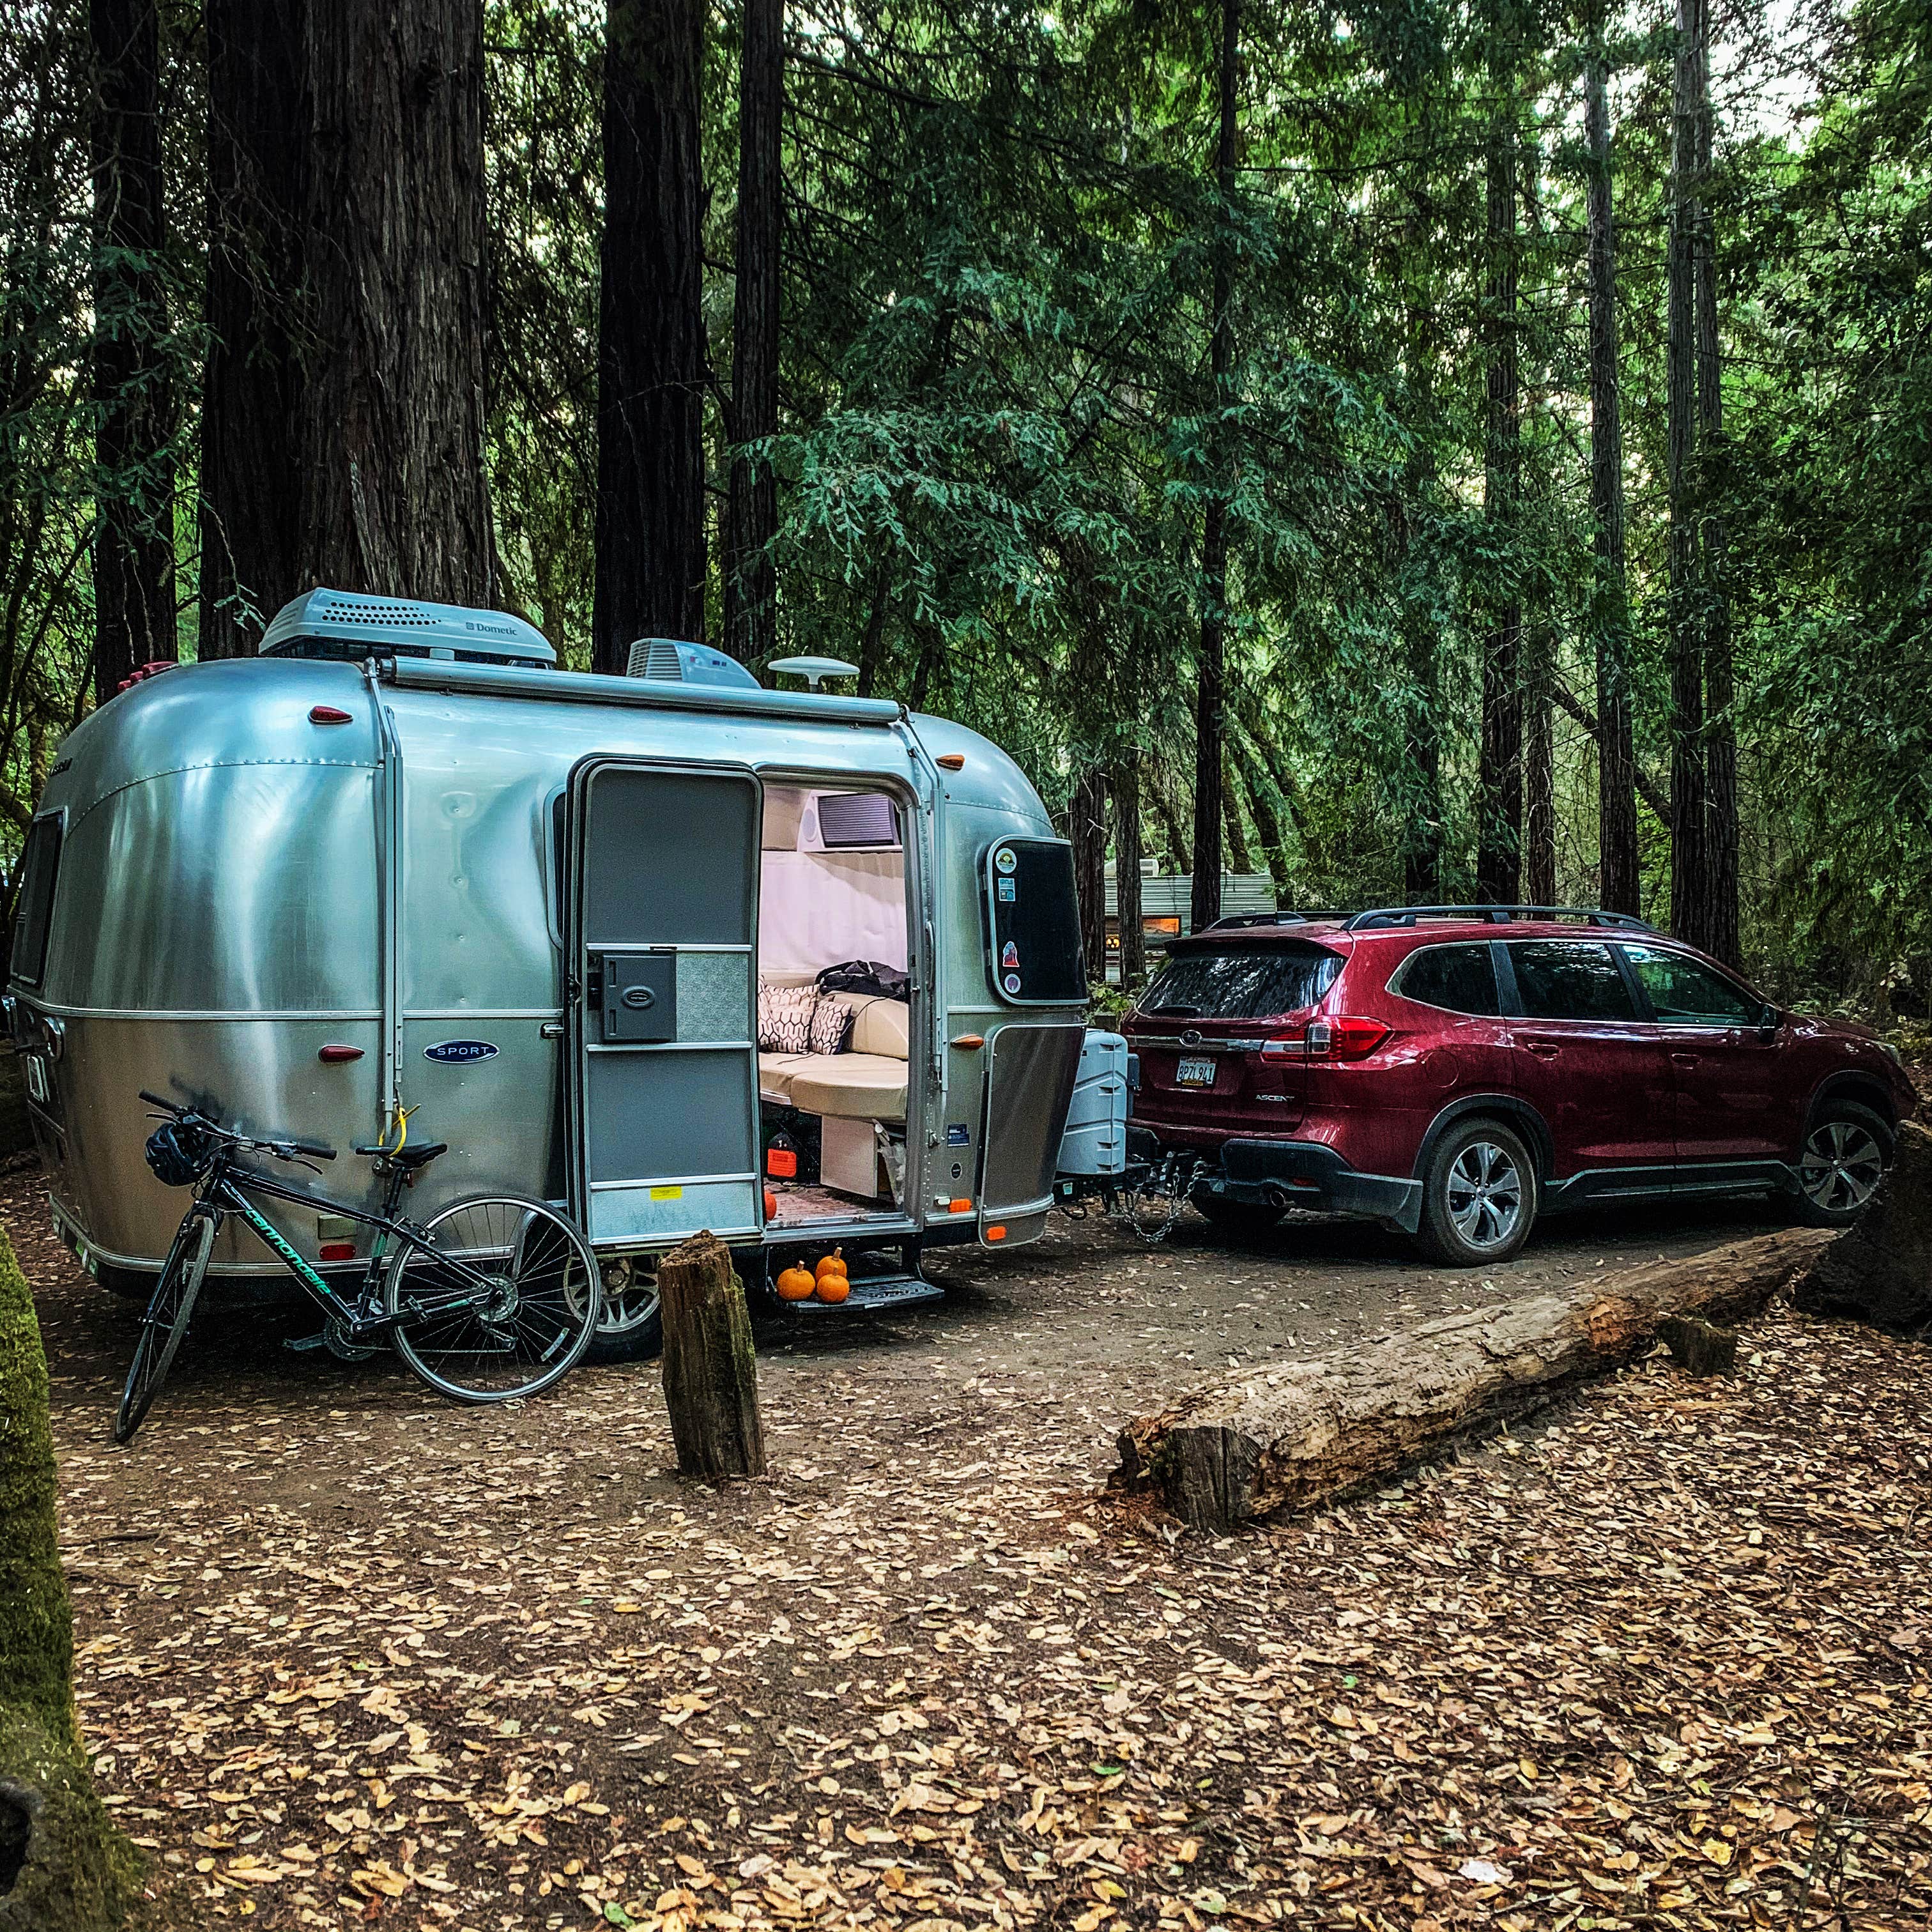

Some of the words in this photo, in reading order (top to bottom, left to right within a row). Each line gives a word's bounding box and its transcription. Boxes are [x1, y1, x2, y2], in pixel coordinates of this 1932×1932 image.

[476, 623, 518, 636] Dometic
[437, 1046, 489, 1055] SPORT
[245, 1207, 331, 1294] cannondale
